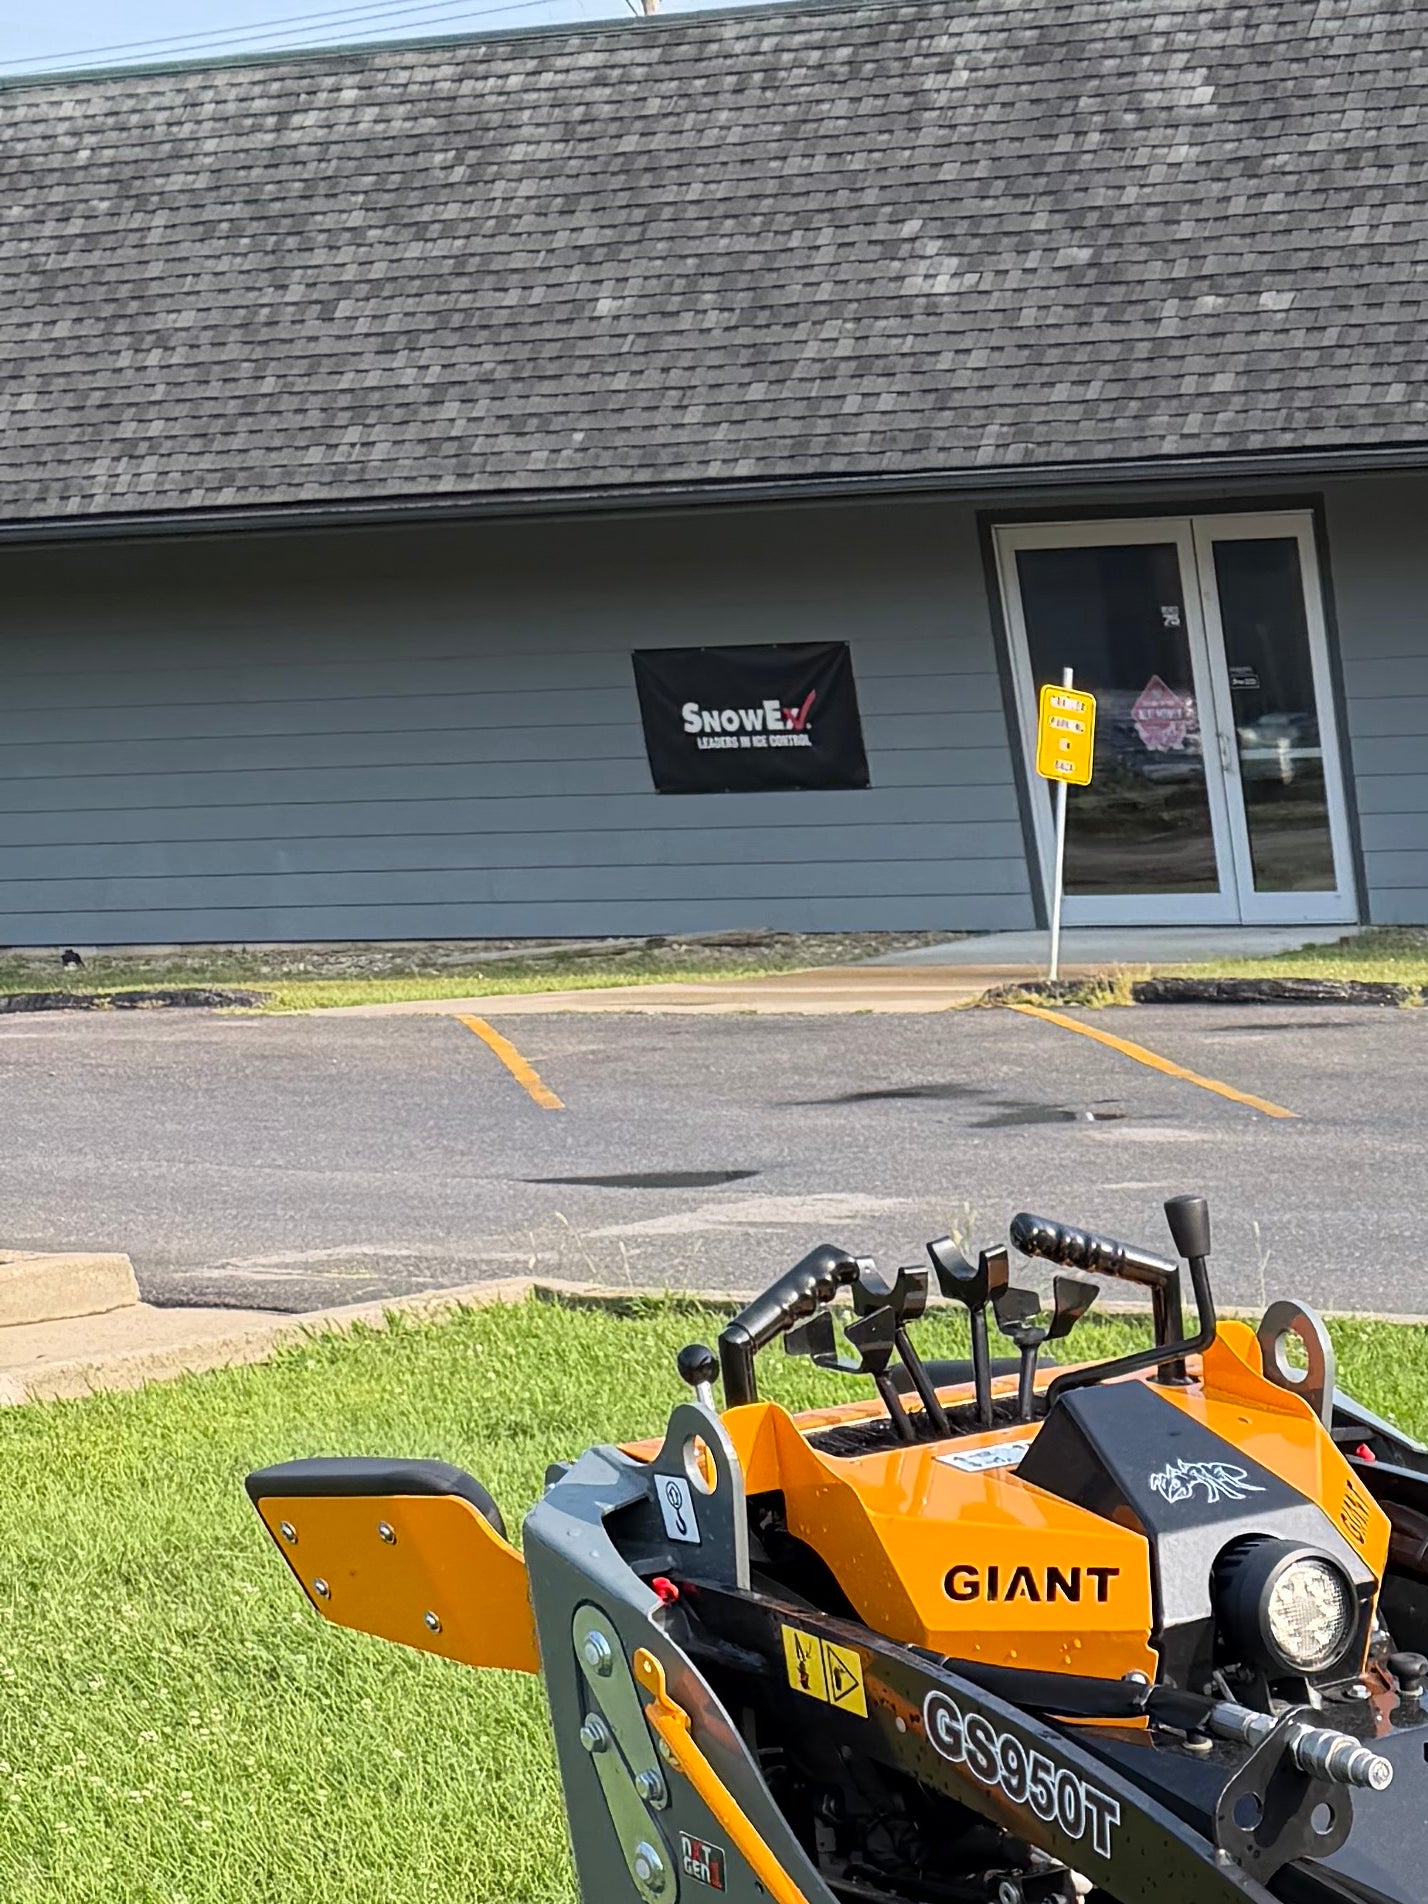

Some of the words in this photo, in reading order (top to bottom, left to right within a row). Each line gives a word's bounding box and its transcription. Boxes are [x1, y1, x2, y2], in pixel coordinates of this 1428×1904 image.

[697, 737, 738, 749] LEADERS
[740, 736, 750, 747] IN
[752, 735, 768, 747] ICE
[769, 734, 812, 747] CONTROL
[944, 1565, 1120, 1602] GIANT
[924, 1690, 1120, 1859] GS950T
